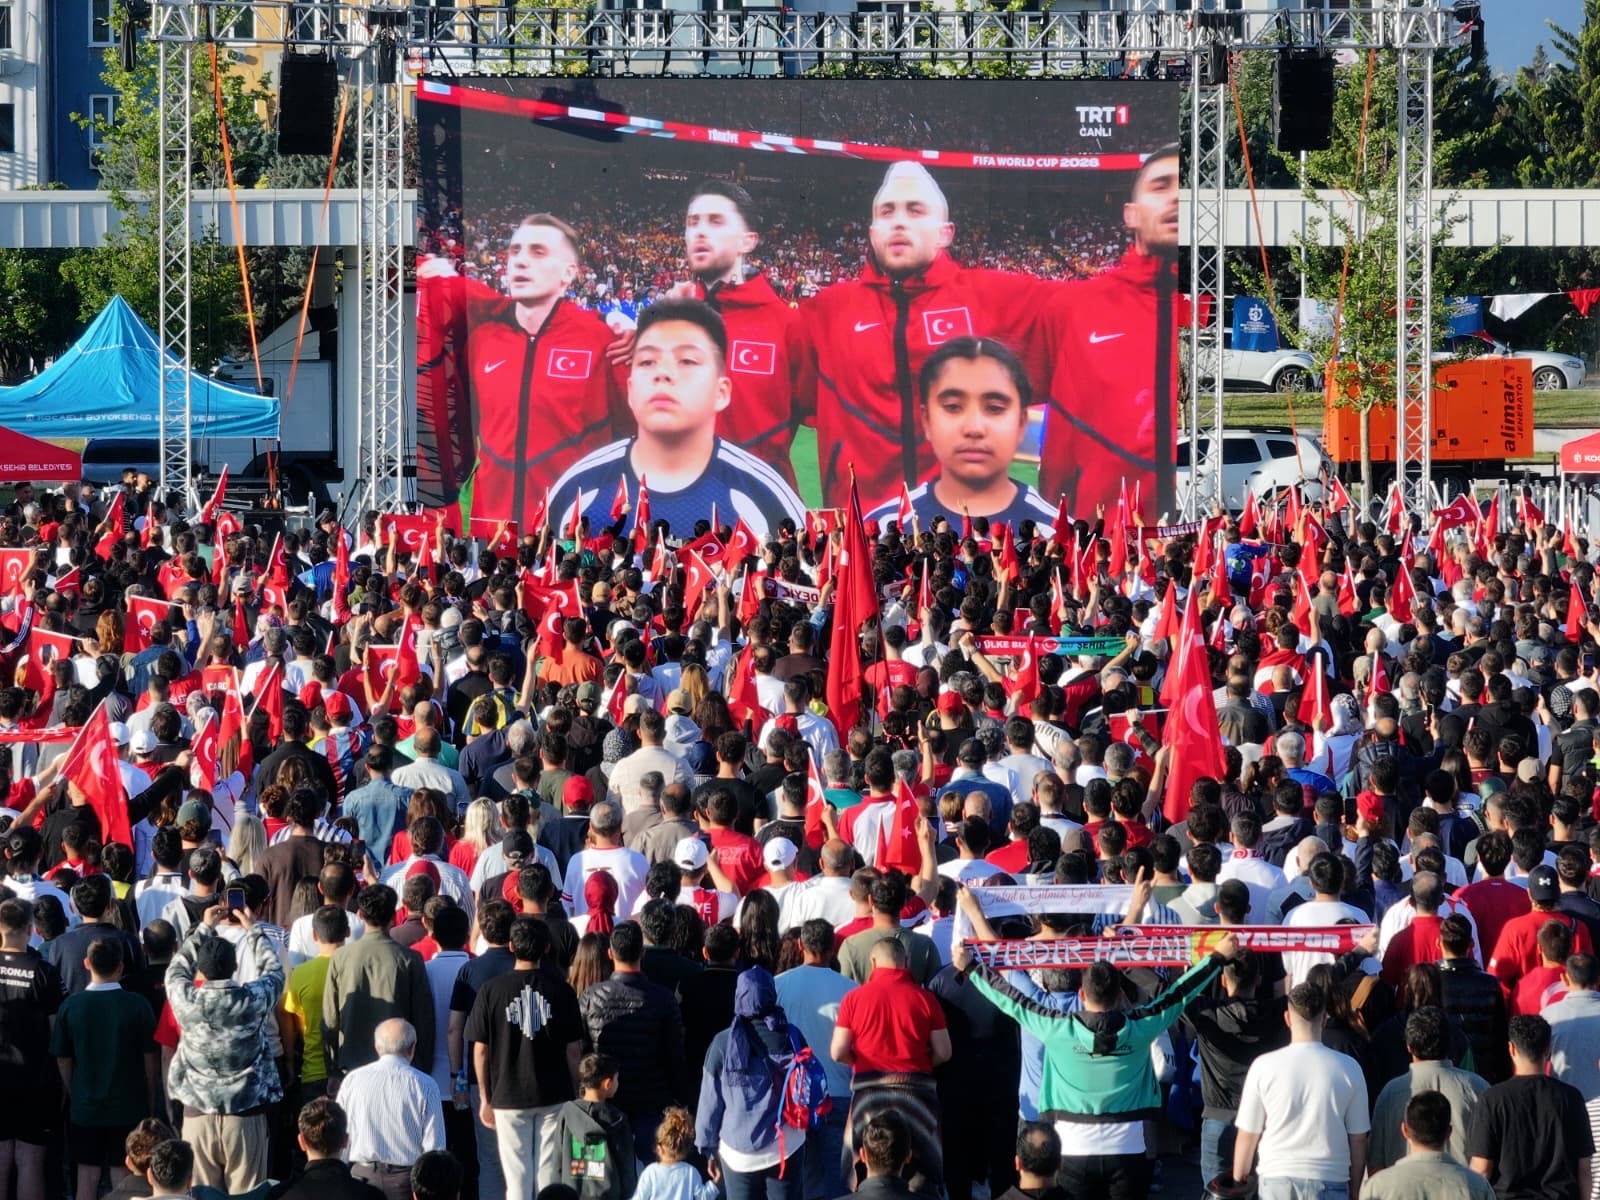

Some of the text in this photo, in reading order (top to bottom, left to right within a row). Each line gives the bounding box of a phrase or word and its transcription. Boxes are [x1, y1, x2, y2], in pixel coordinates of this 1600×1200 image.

[1075, 106, 1116, 123] TRT
[1080, 127, 1112, 137] CANLI
[973, 155, 1100, 168] FIFA WORLD CUP 2026
[1500, 380, 1516, 453] alimar
